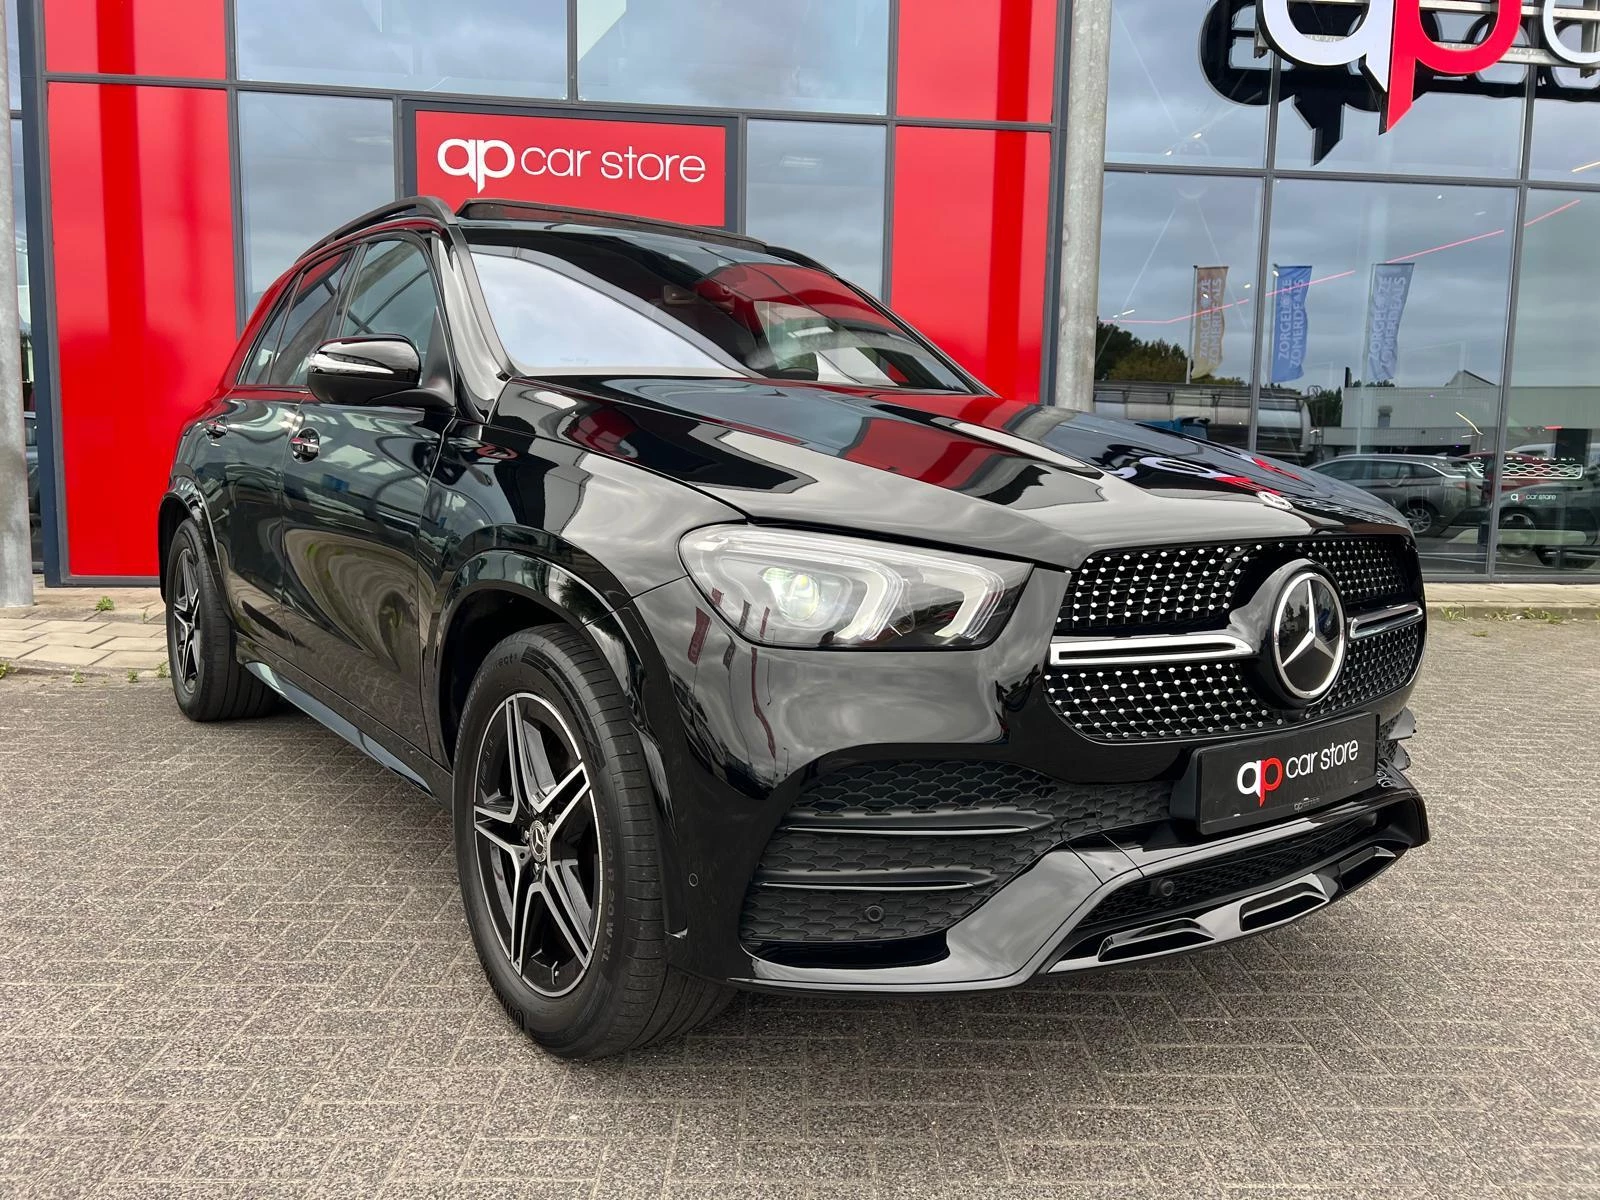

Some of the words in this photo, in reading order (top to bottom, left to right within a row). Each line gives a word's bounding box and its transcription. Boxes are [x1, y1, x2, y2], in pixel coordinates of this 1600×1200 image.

[520, 146, 592, 177] car
[600, 145, 706, 183] store
[1285, 751, 1319, 779] car
[1320, 739, 1359, 770] store
